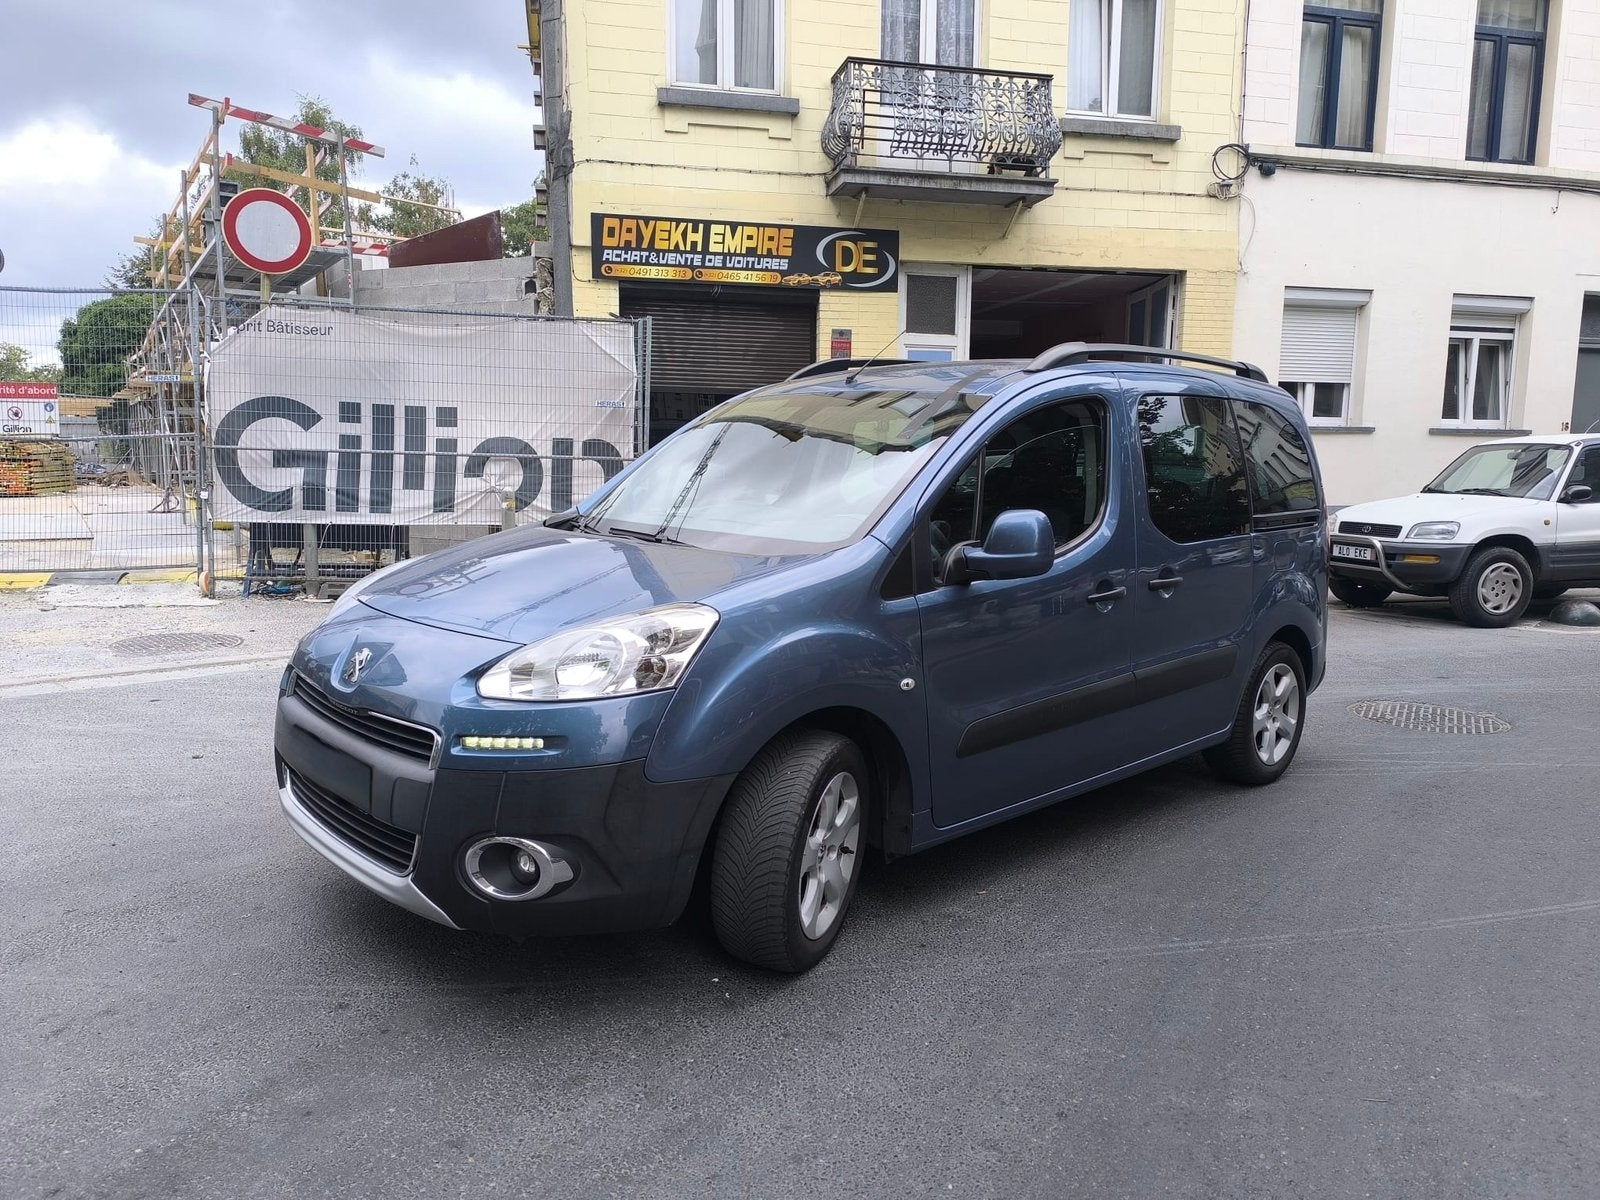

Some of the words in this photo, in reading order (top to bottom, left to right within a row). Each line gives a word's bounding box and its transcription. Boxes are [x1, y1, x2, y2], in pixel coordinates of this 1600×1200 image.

[602, 217, 703, 251] DAYEKH
[709, 224, 794, 256] EMPIRE
[705, 255, 723, 267] DE
[726, 256, 789, 270] VOITURES
[835, 240, 878, 274] DE
[628, 267, 652, 277] 0491
[654, 268, 669, 277] 313
[671, 269, 686, 278] 313
[717, 272, 741, 281] 0465
[743, 273, 753, 281] 41
[755, 274, 766, 282] 56
[267, 319, 334, 336] Bâtisseur
[18, 386, 57, 395] d'abord
[2, 424, 32, 433] Gillion
[214, 396, 626, 514] Gillion
